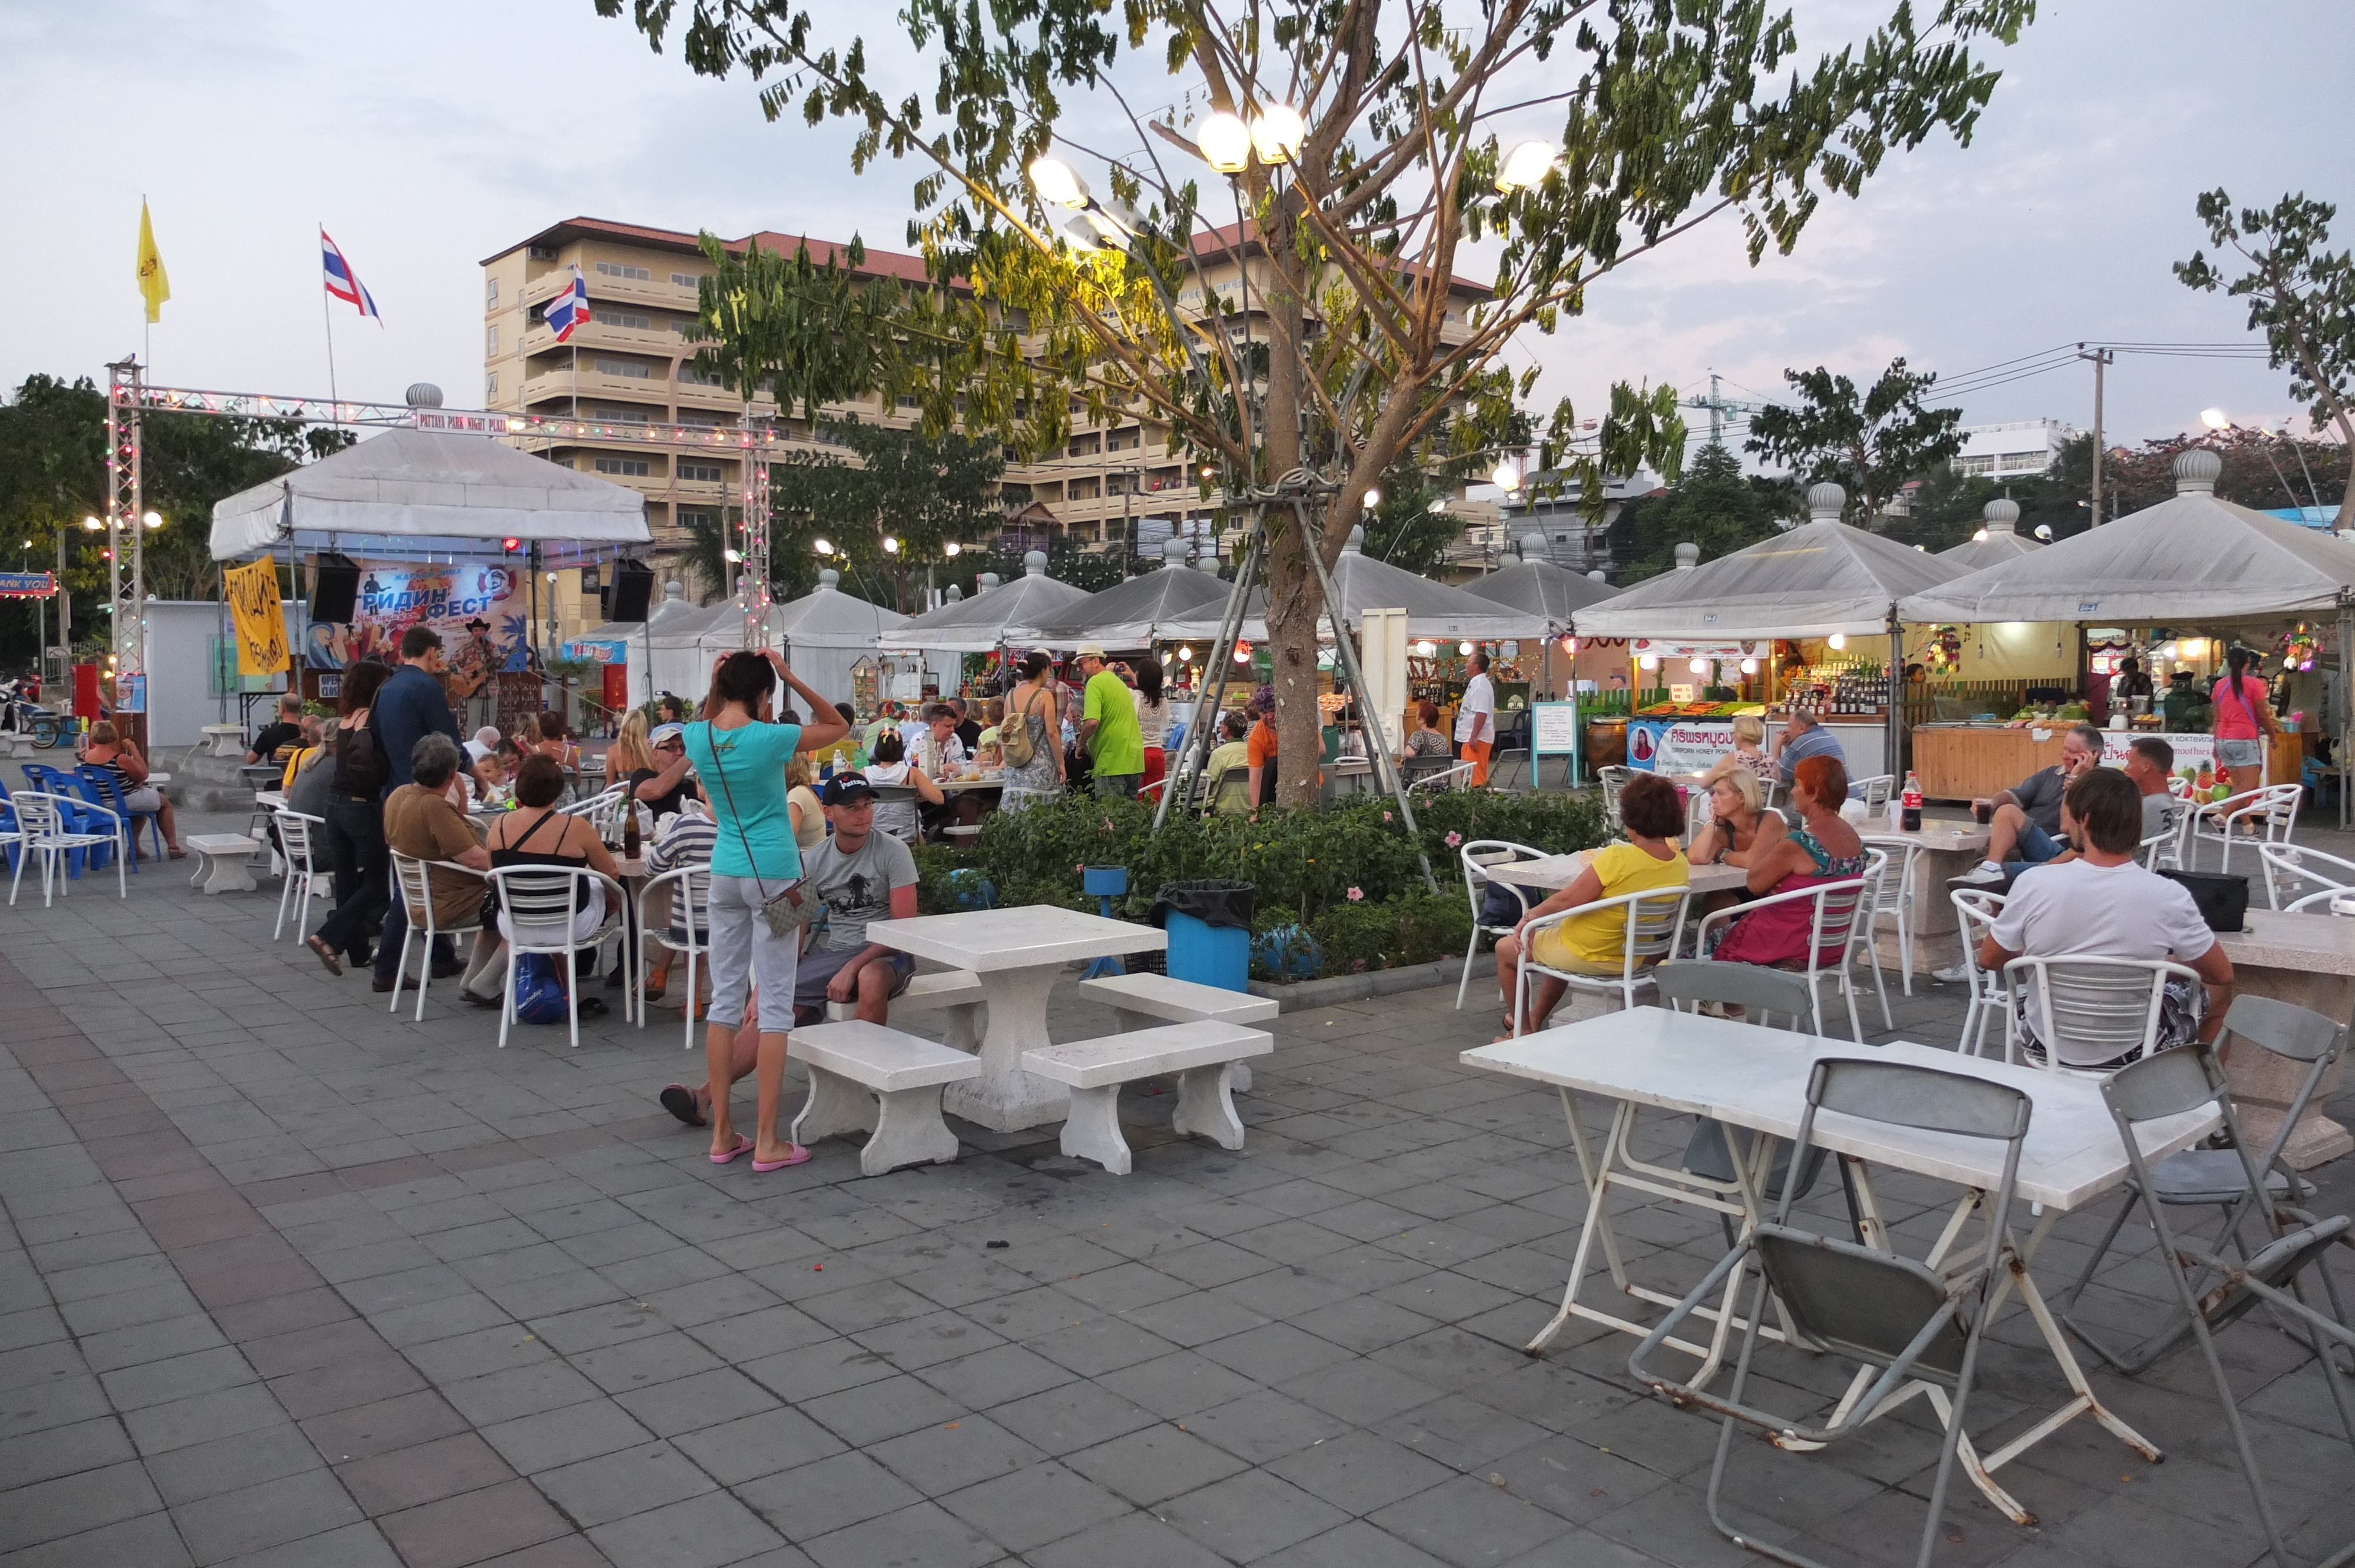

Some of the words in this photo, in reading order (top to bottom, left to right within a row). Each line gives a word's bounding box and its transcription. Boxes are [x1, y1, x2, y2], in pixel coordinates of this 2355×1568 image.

[420, 414, 445, 428] PATTAYA
[447, 416, 464, 429] PARK
[467, 417, 485, 431] NIGHT
[489, 418, 506, 432] PLAZA
[25, 580, 48, 589] YOU
[356, 587, 448, 612] РИДИН
[427, 596, 492, 619] ФЕСТ
[2172, 747, 2210, 755] moothies
